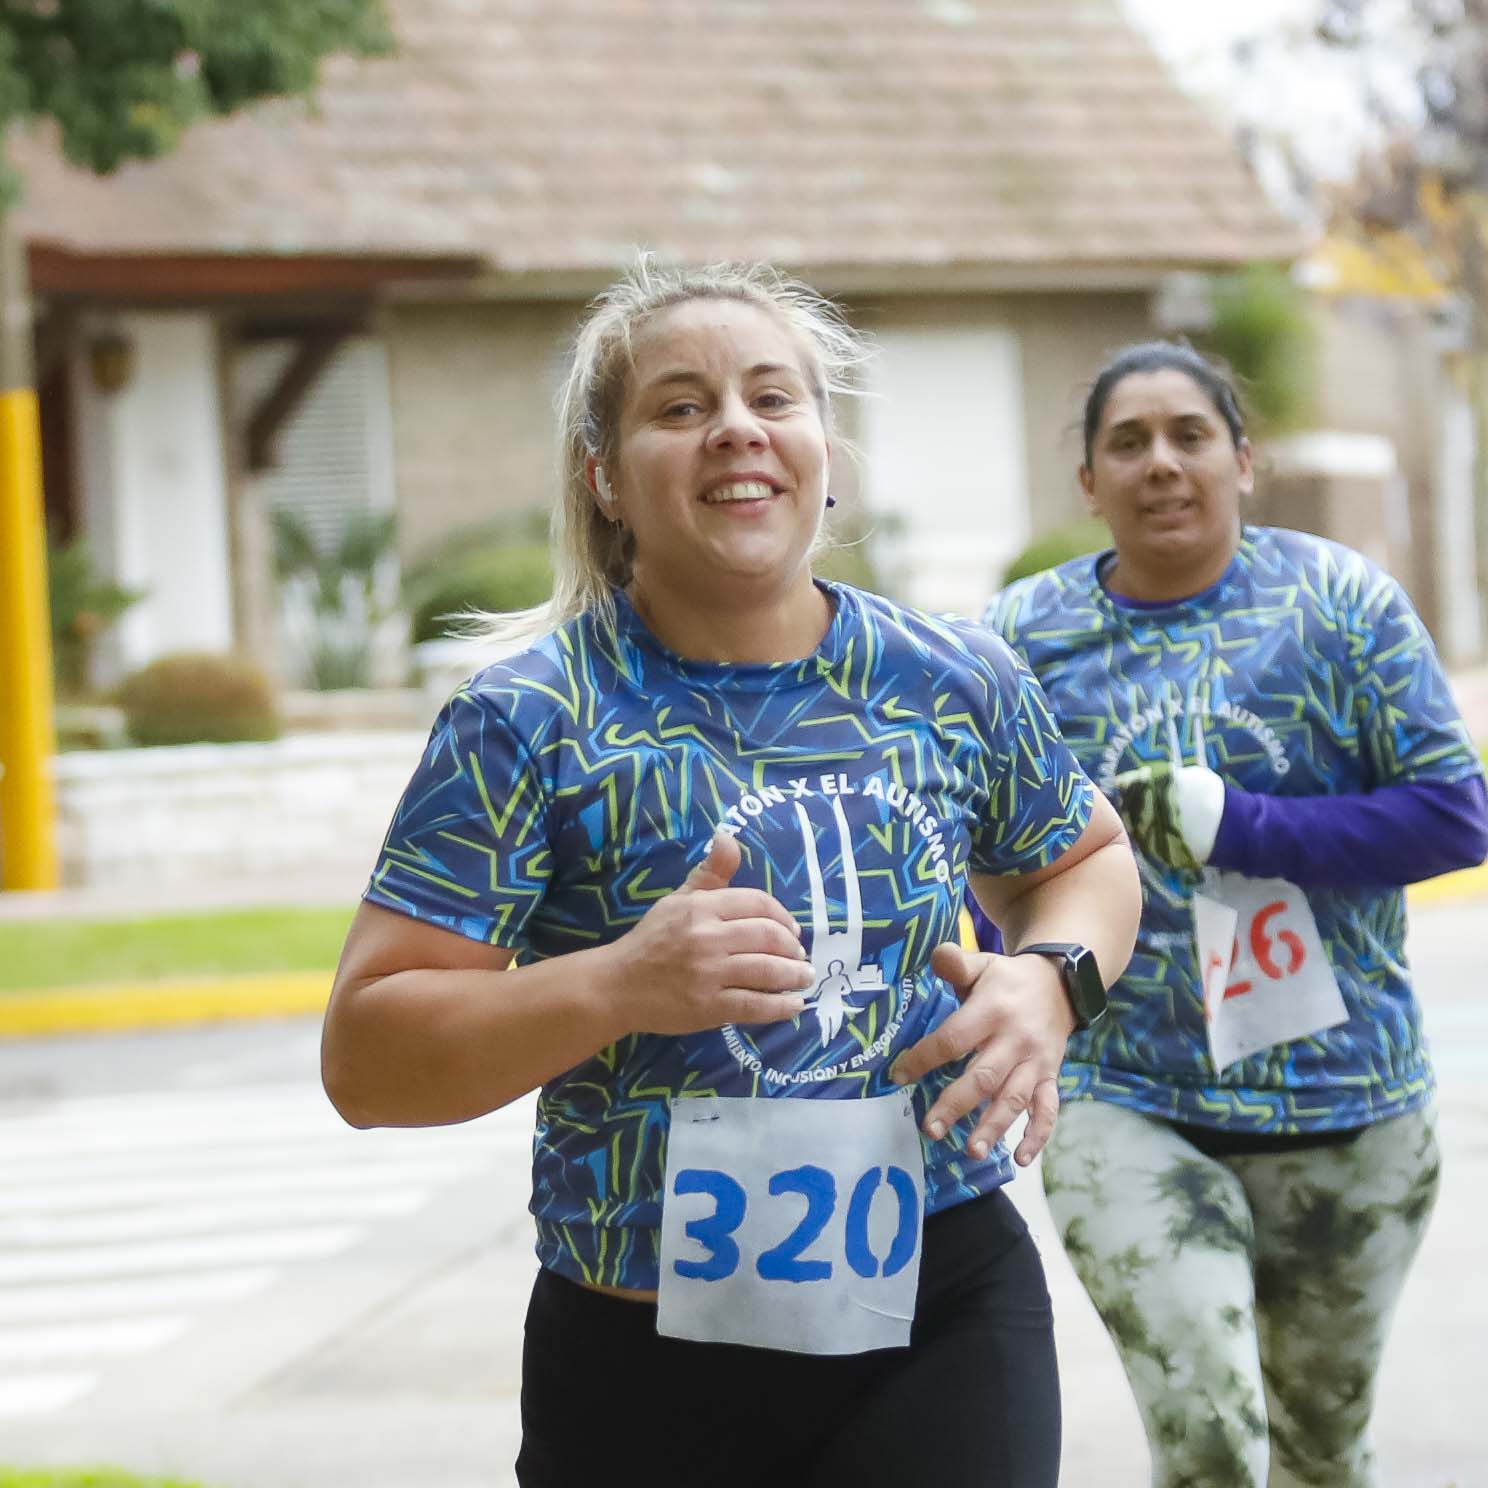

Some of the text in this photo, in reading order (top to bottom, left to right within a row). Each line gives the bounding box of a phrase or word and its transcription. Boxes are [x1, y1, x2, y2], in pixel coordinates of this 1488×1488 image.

[704, 773, 948, 883] ATÓN X EL AUTISMO
[839, 1060, 848, 1072] Y
[673, 1165, 917, 1283] 320
